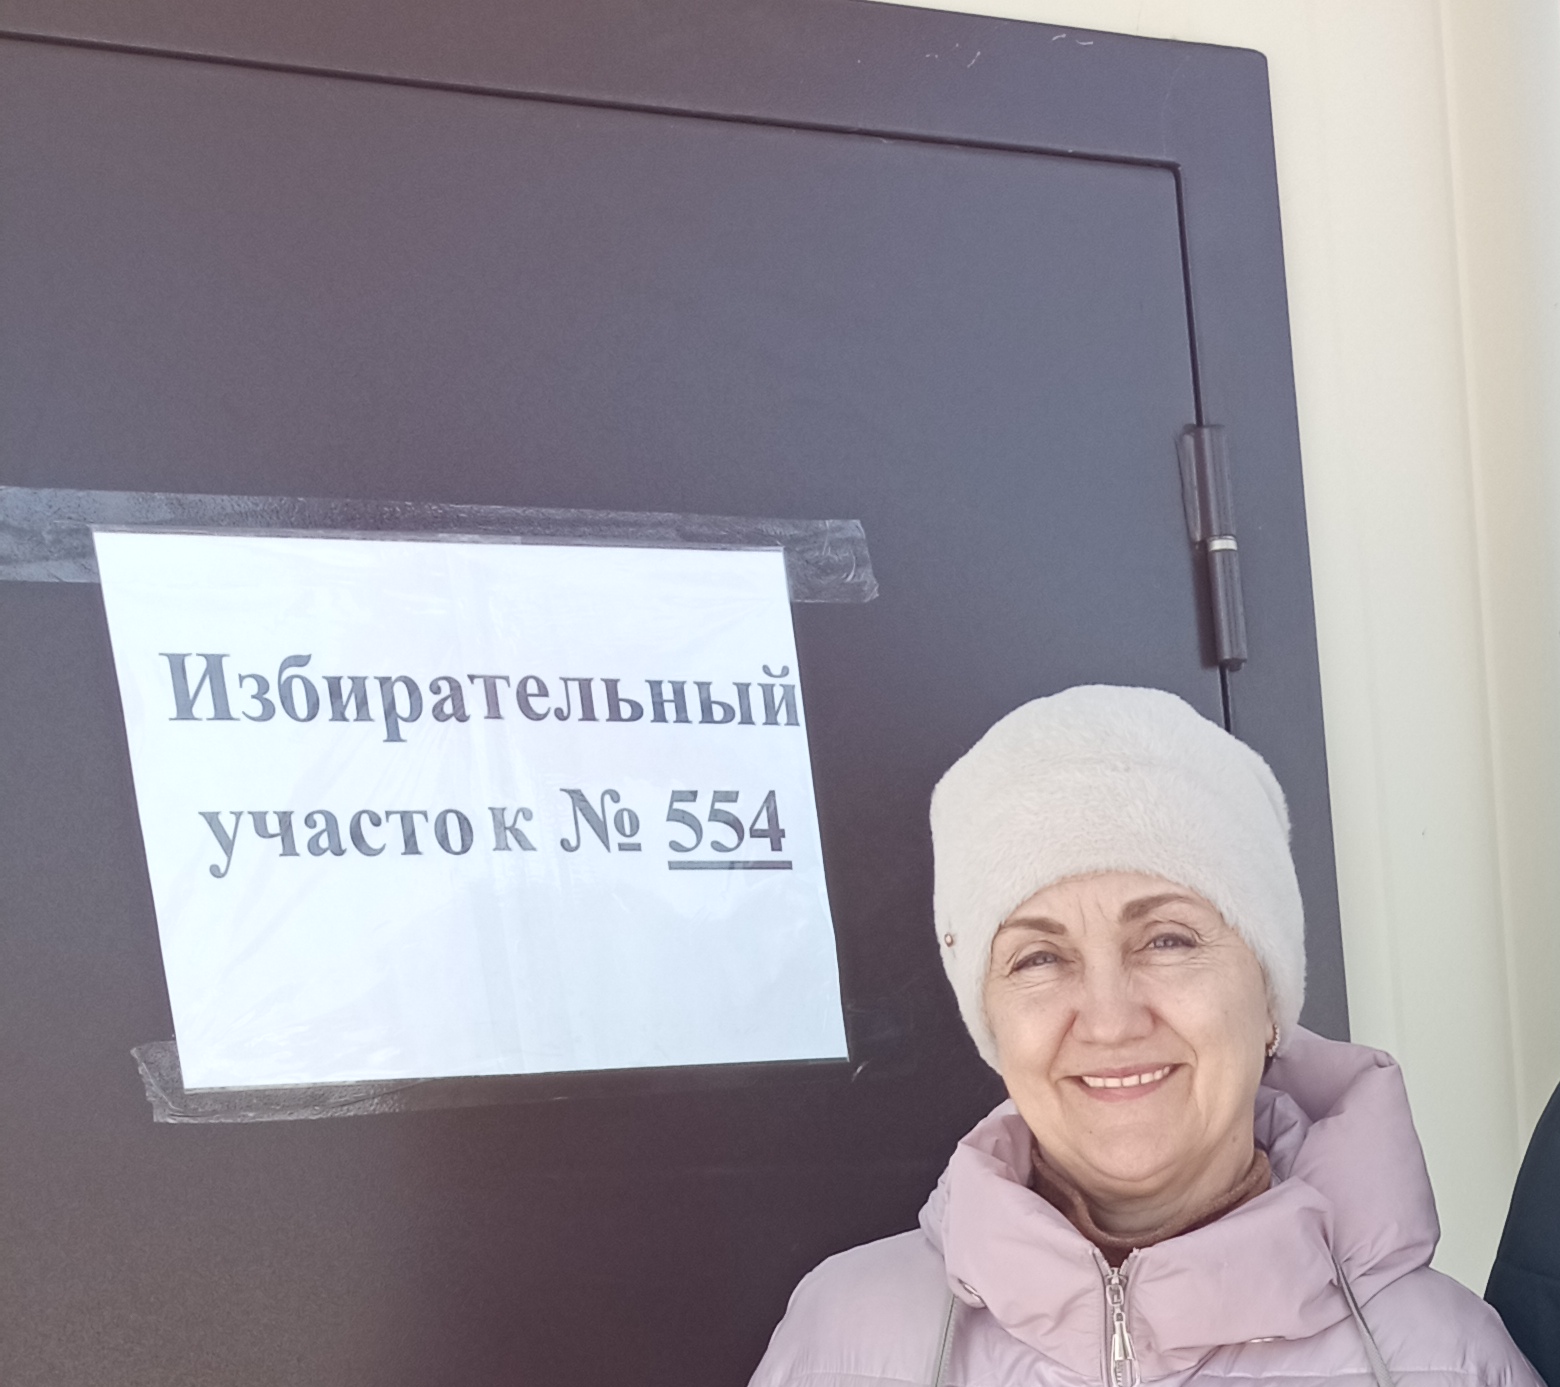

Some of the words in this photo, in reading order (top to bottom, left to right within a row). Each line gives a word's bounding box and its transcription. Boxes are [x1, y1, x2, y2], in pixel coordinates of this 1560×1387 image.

[156, 652, 801, 743] Избирательный
[559, 787, 643, 853] №
[666, 788, 788, 856] 554
